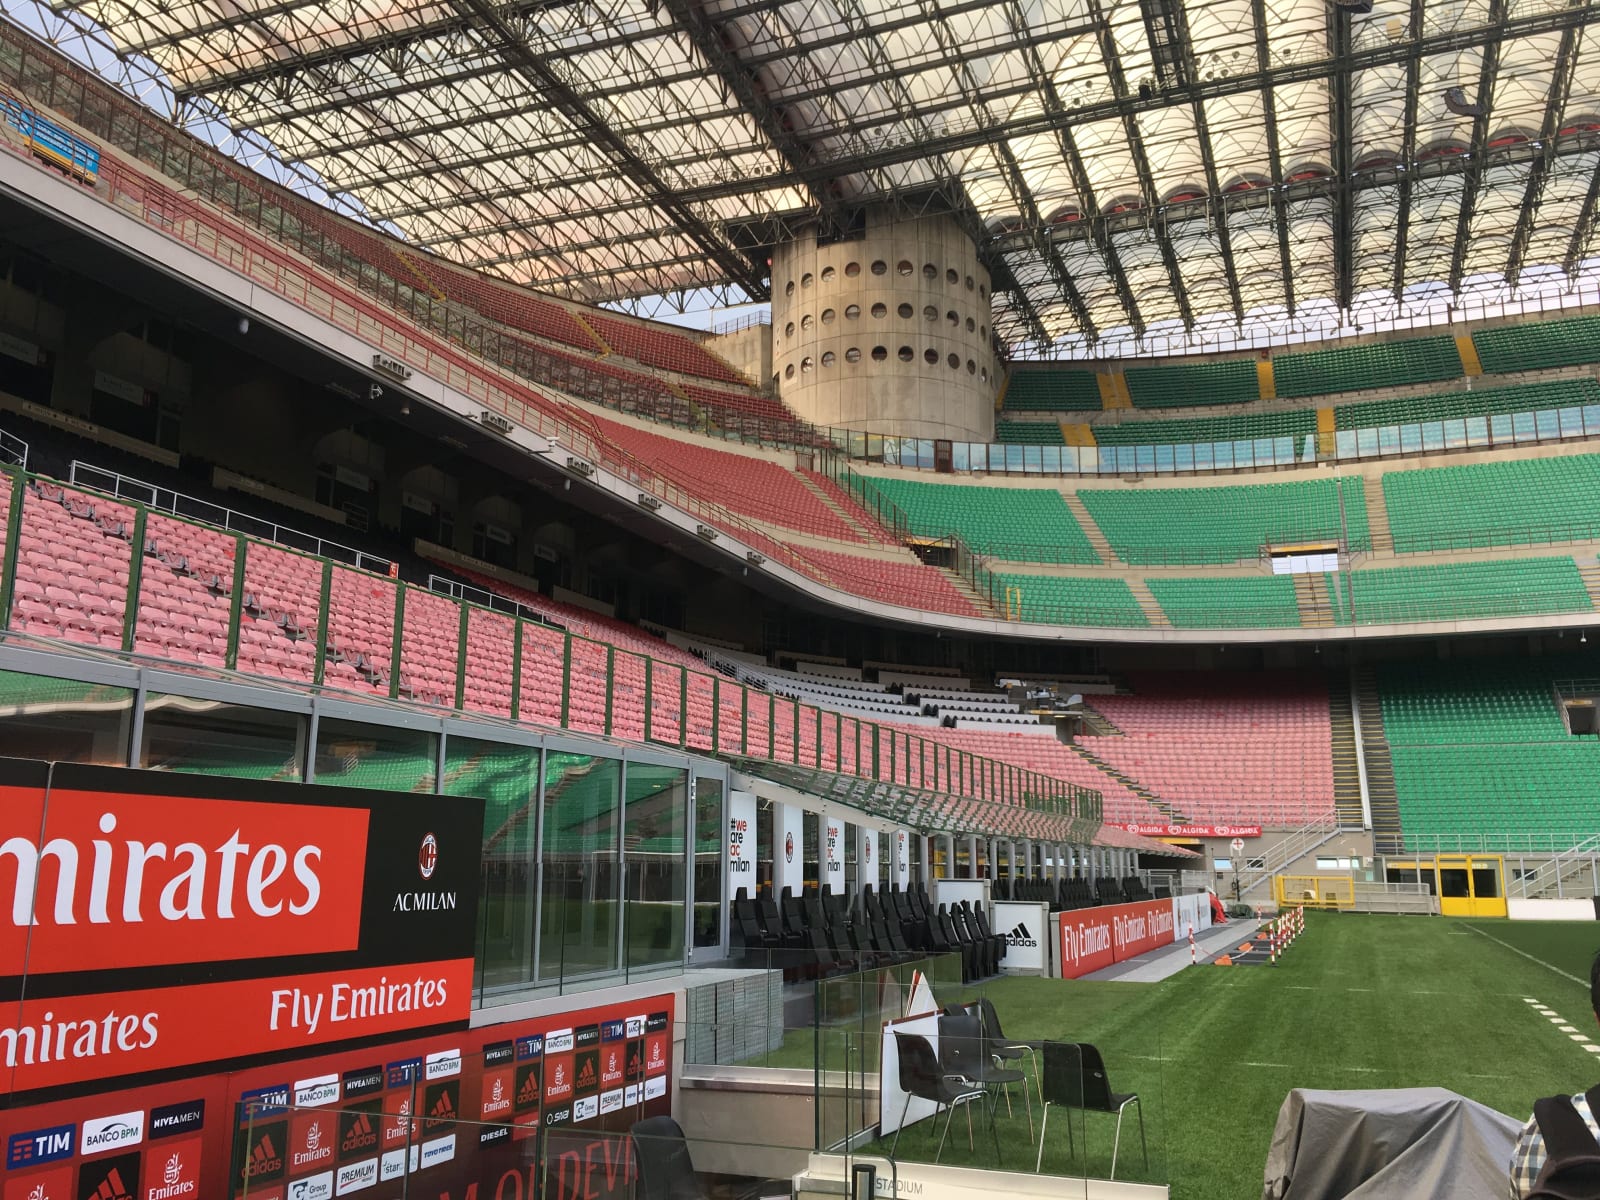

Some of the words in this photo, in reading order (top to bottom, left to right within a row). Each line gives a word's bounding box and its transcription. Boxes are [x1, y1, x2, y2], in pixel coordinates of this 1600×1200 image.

[730, 831, 743, 844] are
[1230, 827, 1259, 835] ALGIDA
[730, 844, 741, 856] ac
[730, 856, 750, 872] milan
[1113, 915, 1125, 952] Fly
[1123, 911, 1146, 944] Emirates
[1147, 910, 1157, 942] Fly
[1155, 907, 1173, 935] Emirates
[1064, 924, 1079, 967] Fly
[1079, 919, 1111, 957] Emirates
[270, 988, 324, 1035] Fly
[330, 976, 448, 1022] Emirates
[428, 1063, 448, 1074] BANCO
[299, 1091, 323, 1104] BANCO
[323, 1087, 336, 1099] BPM
[547, 1083, 571, 1097] Emirates
[260, 1090, 288, 1111] TIM
[483, 1099, 510, 1113] Emirates
[36, 1131, 71, 1156] TIM
[86, 1130, 120, 1146] BANCO
[120, 1126, 139, 1140] BPM
[342, 1132, 377, 1151] adidas
[480, 1127, 509, 1142] DIESEL
[294, 1146, 331, 1165] Emirates
[340, 1163, 375, 1183] PREMIUM
[149, 1180, 194, 1200] Emirates
[308, 1184, 327, 1194] Group
